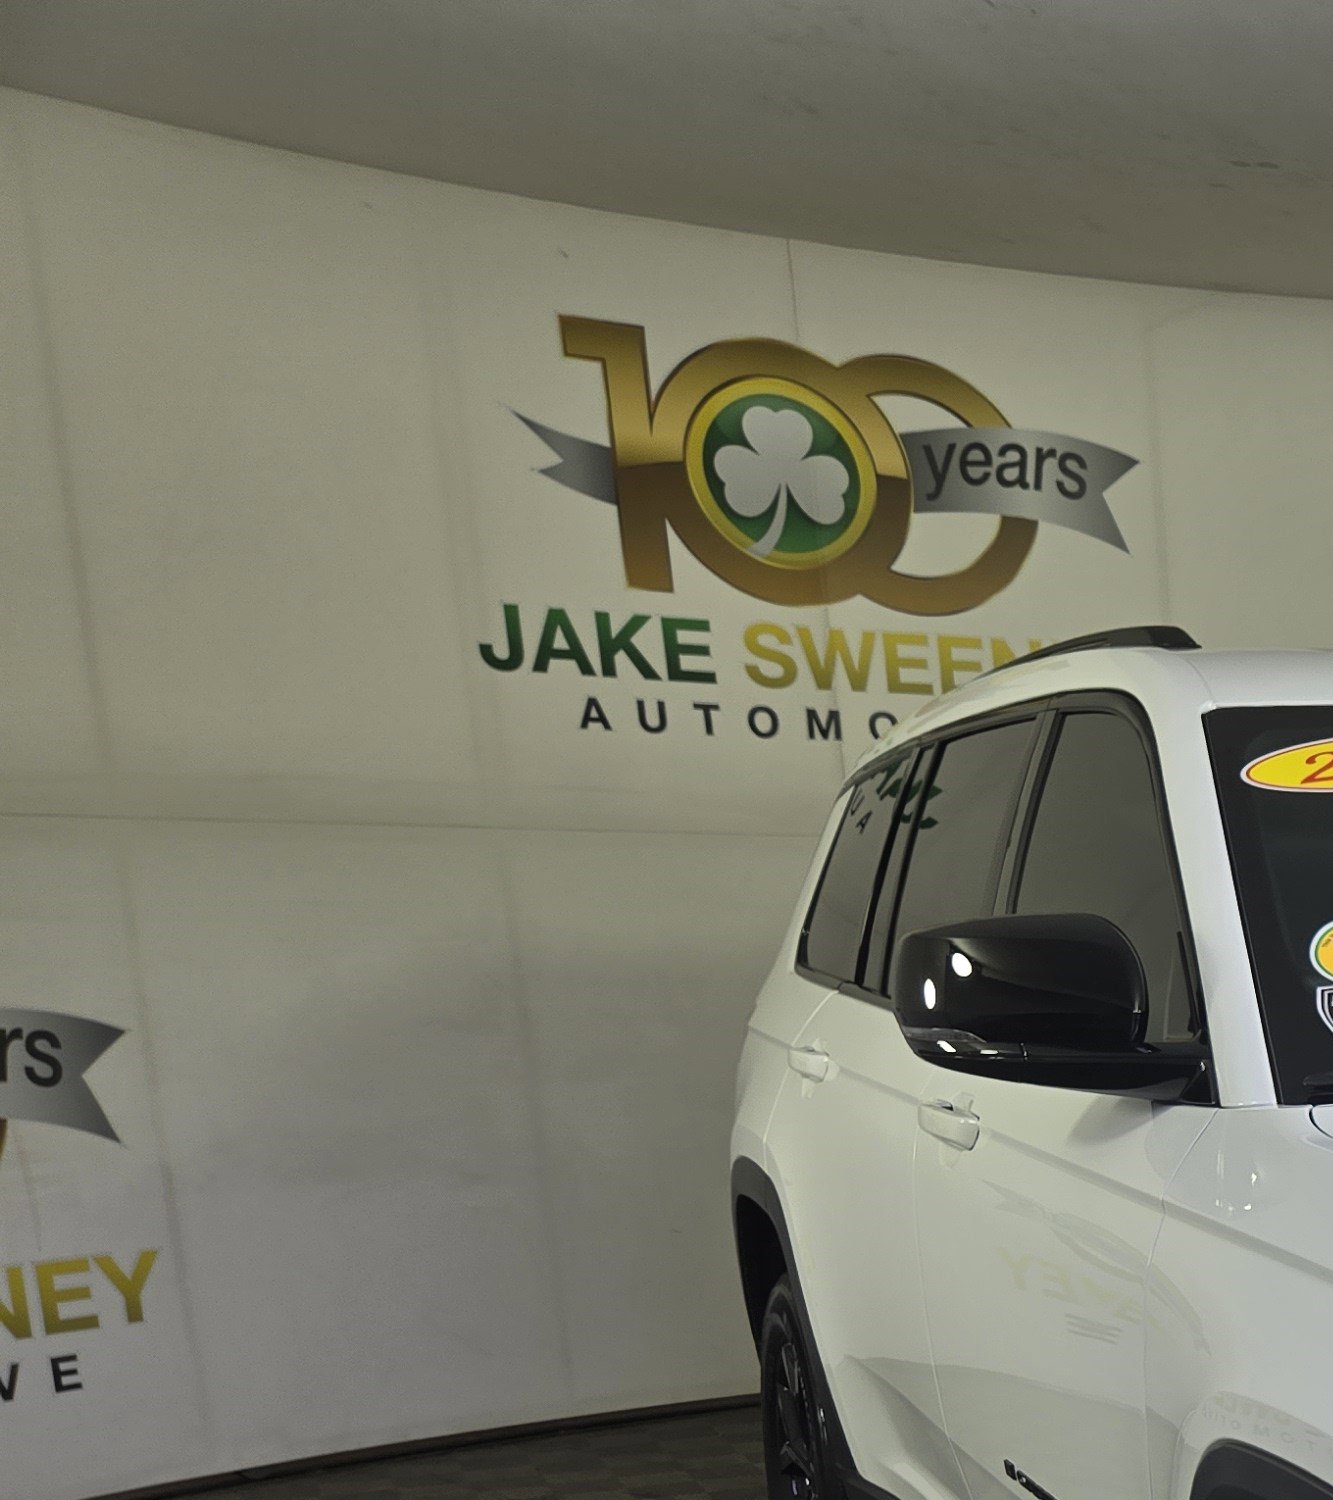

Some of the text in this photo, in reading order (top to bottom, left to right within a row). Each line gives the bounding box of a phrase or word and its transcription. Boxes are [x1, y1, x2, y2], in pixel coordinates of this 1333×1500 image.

[559, 314, 1088, 616] 100 years
[478, 603, 1043, 696] JAKE SWEE
[579, 696, 899, 741] AUTOMO
